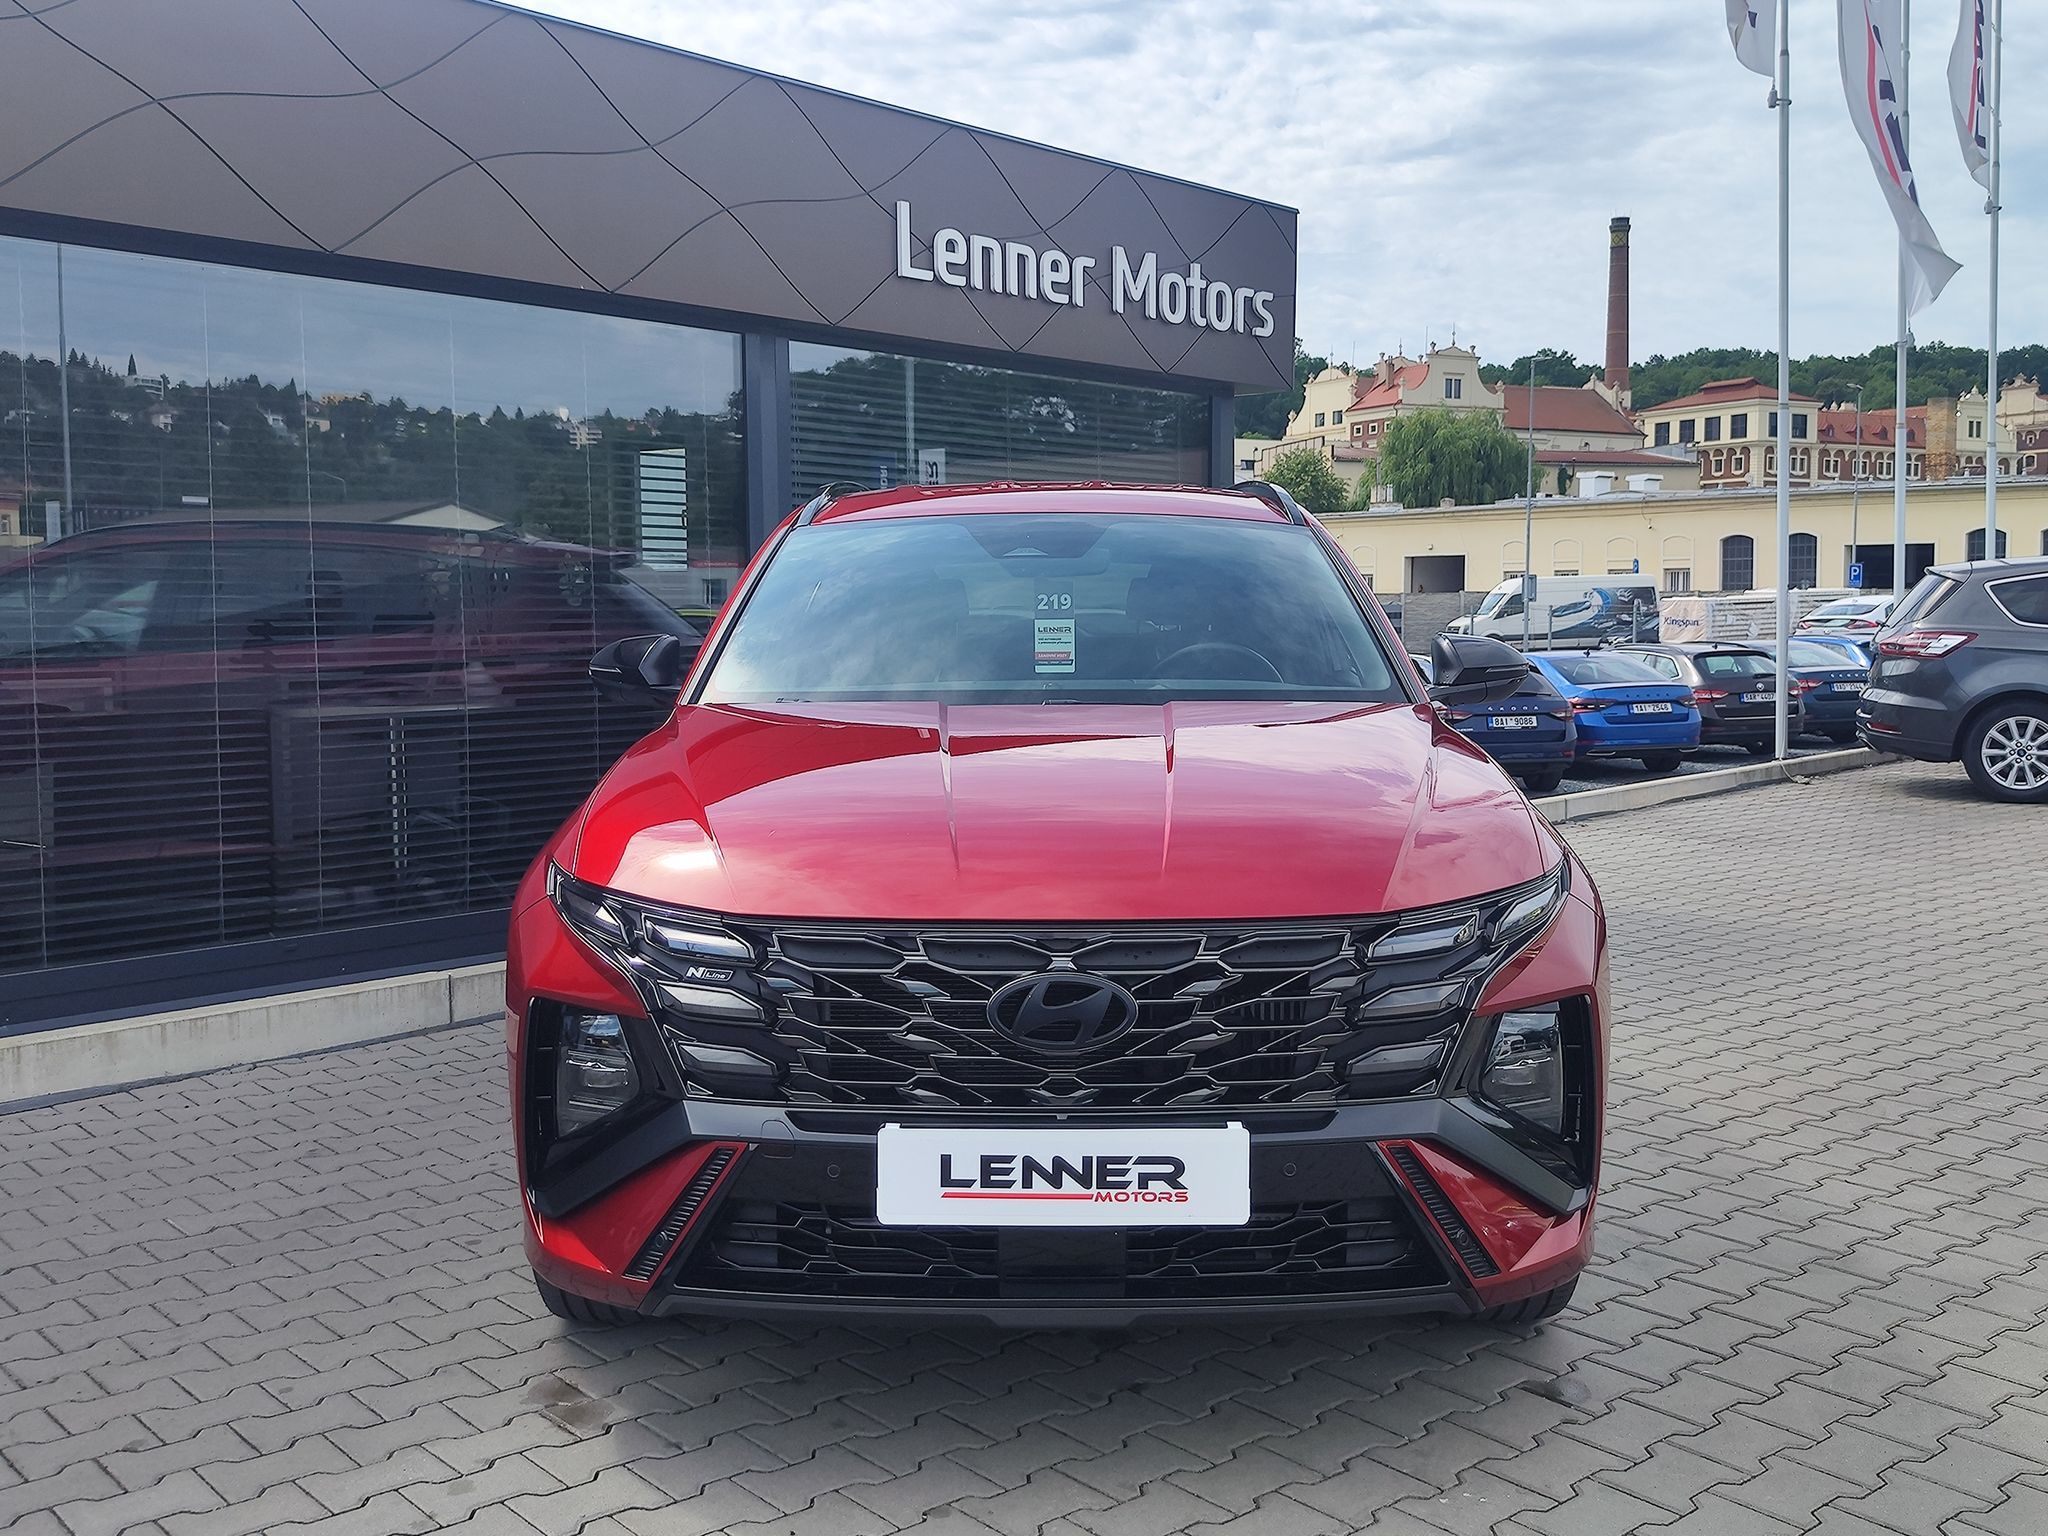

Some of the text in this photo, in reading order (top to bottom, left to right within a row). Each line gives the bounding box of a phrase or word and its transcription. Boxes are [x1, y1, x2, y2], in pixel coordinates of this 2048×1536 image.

[896, 200, 1275, 338] Lenner Motors
[1850, 566, 1860, 580] P
[1037, 593, 1072, 610] 219
[1037, 626, 1072, 634] LENNER
[686, 966, 726, 979] N Line
[939, 1153, 1188, 1190] LENNER
[1094, 1191, 1189, 1203] MOTORS
